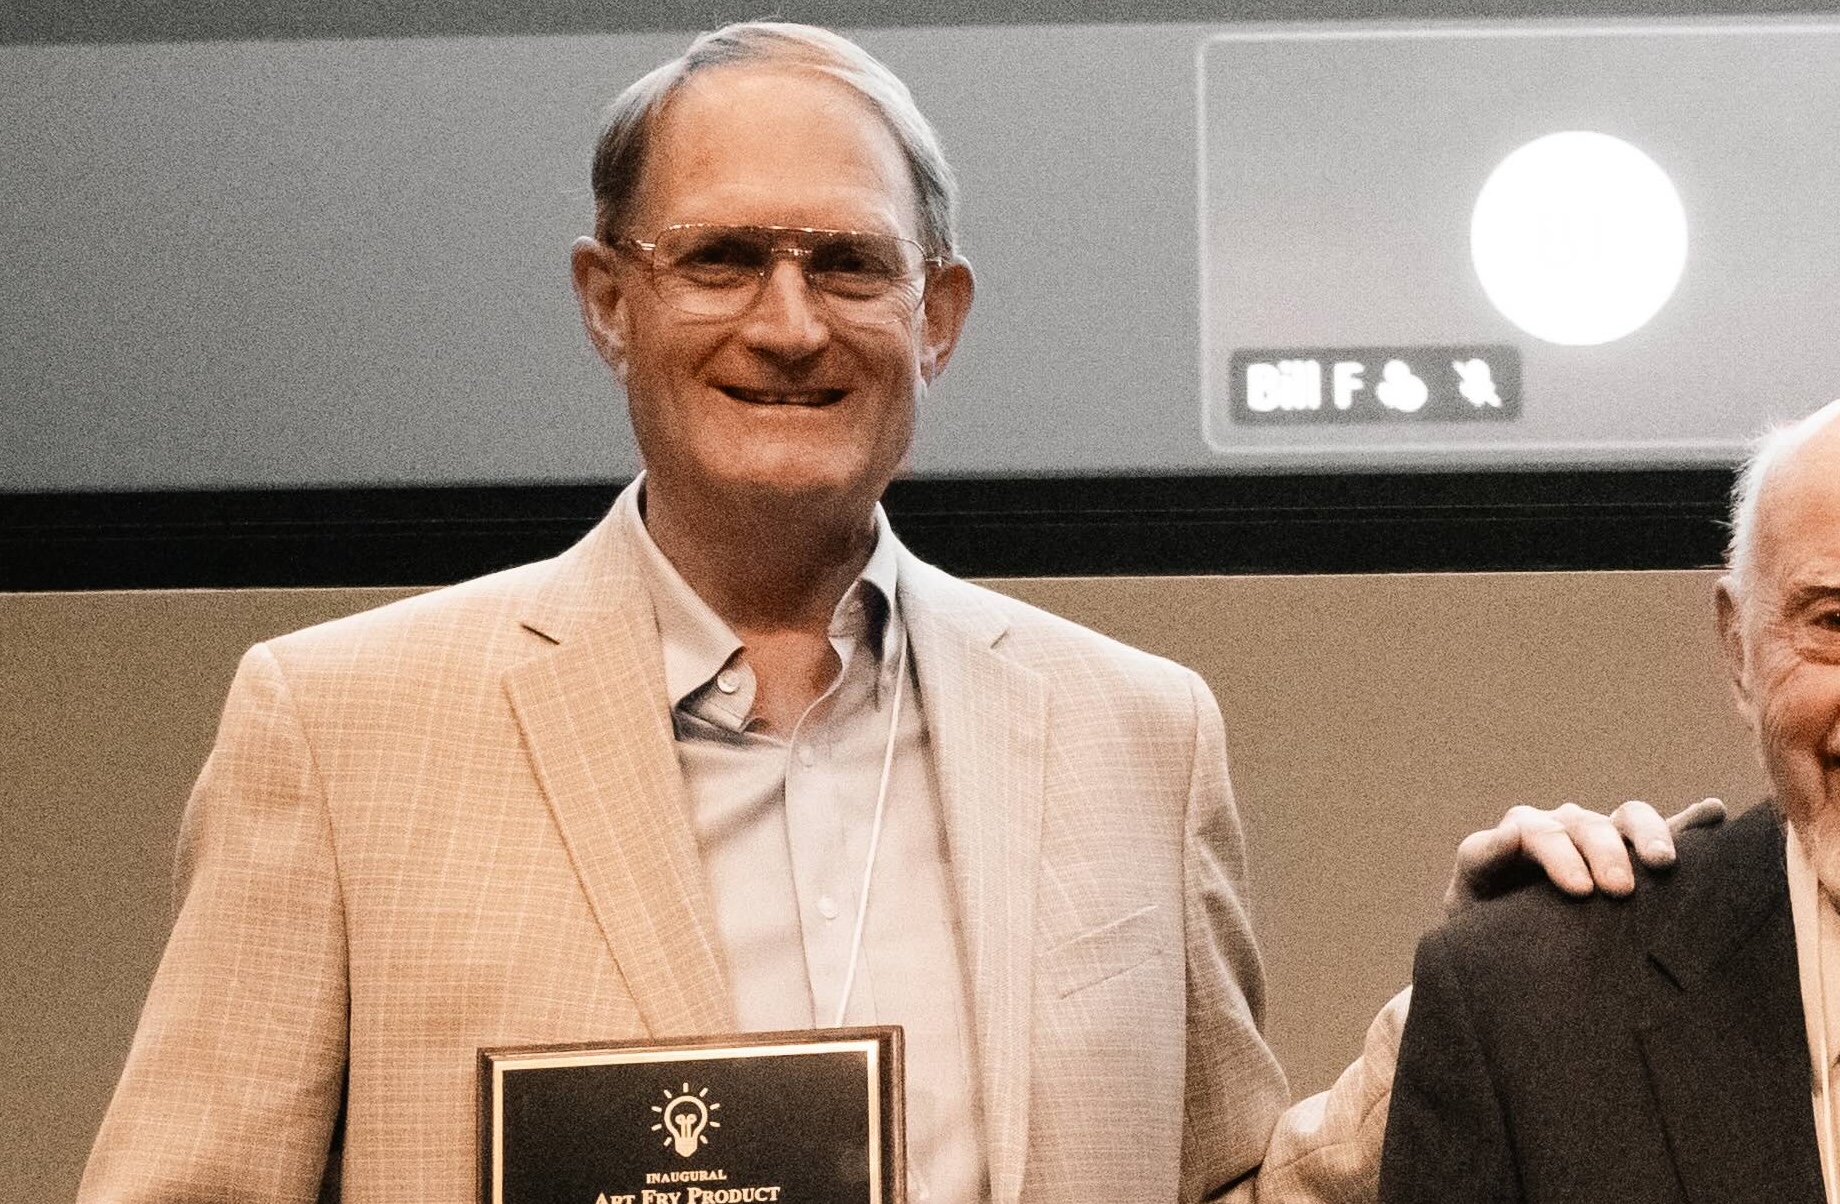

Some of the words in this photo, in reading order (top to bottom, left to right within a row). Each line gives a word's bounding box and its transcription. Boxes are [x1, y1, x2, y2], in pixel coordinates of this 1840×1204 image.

[1247, 359, 1321, 412] Bill
[1333, 361, 1365, 410] F
[645, 1169, 728, 1185] INAUGURAL
